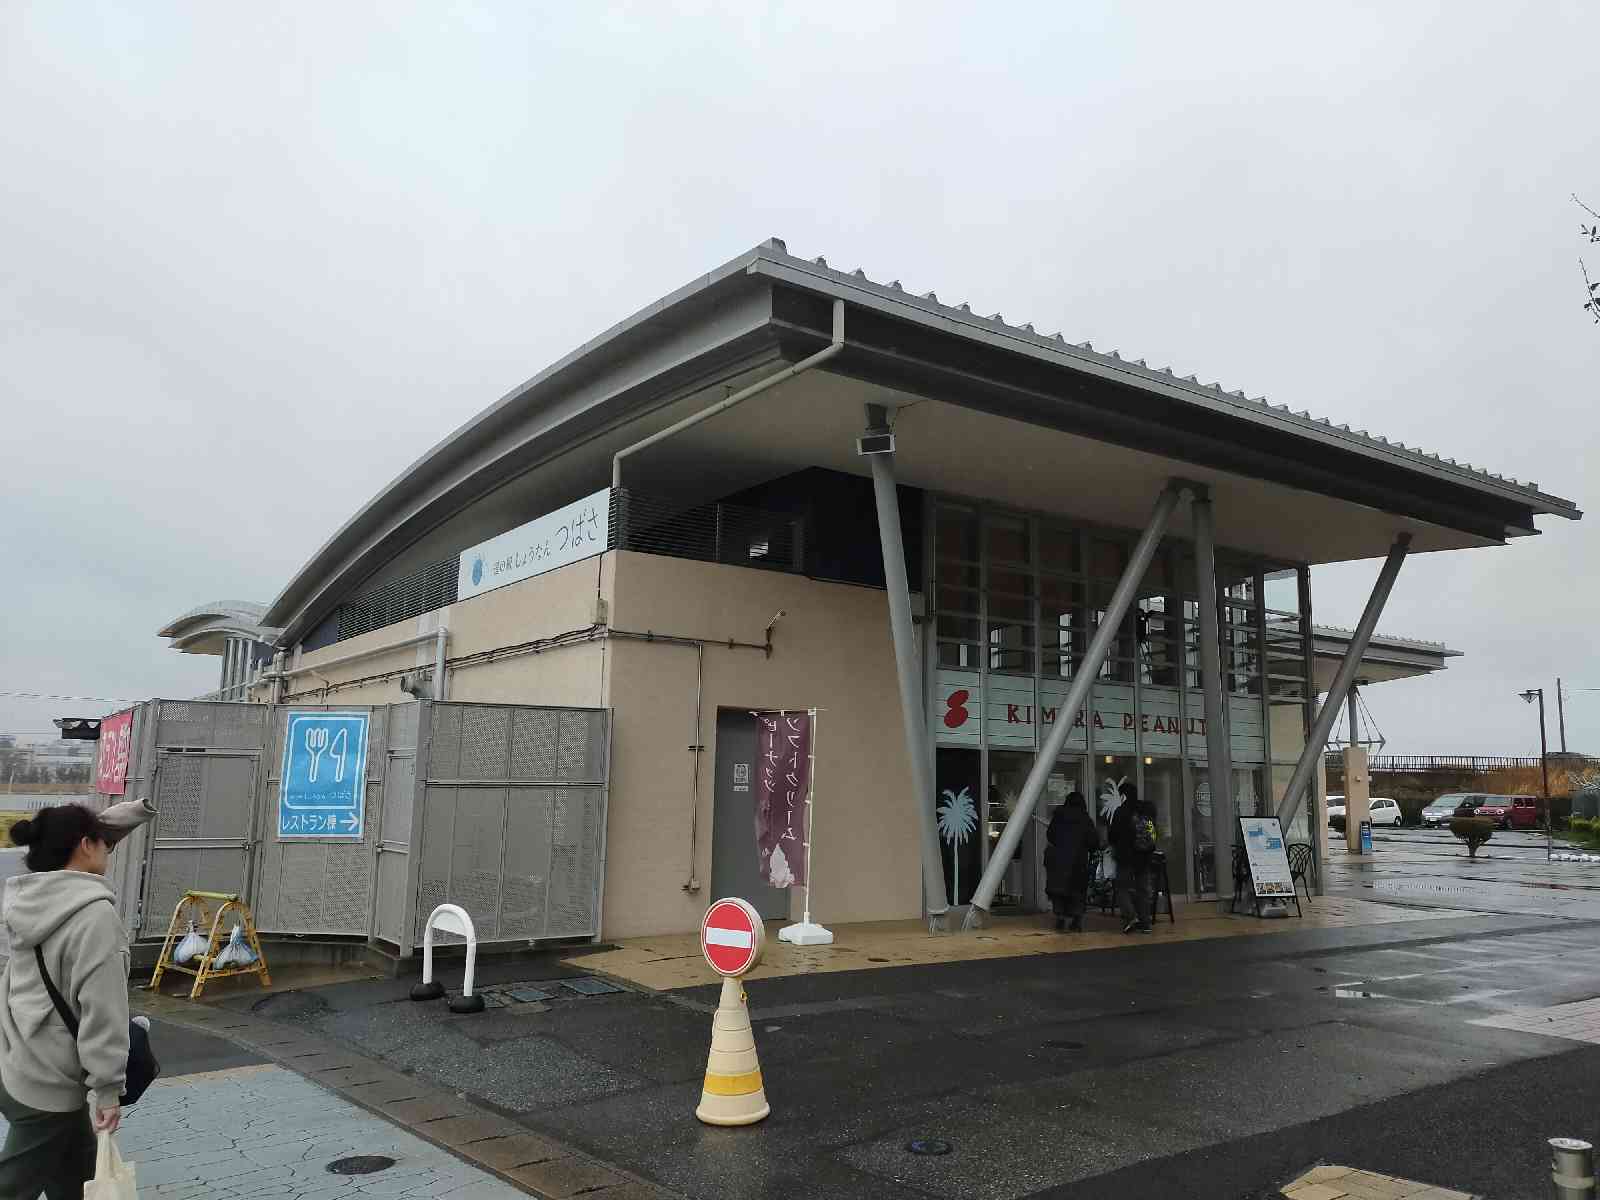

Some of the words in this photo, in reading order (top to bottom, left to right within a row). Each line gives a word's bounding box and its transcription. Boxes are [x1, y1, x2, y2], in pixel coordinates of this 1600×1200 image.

[555, 507, 599, 552] つばさ
[1007, 703, 1105, 730] KIMRA
